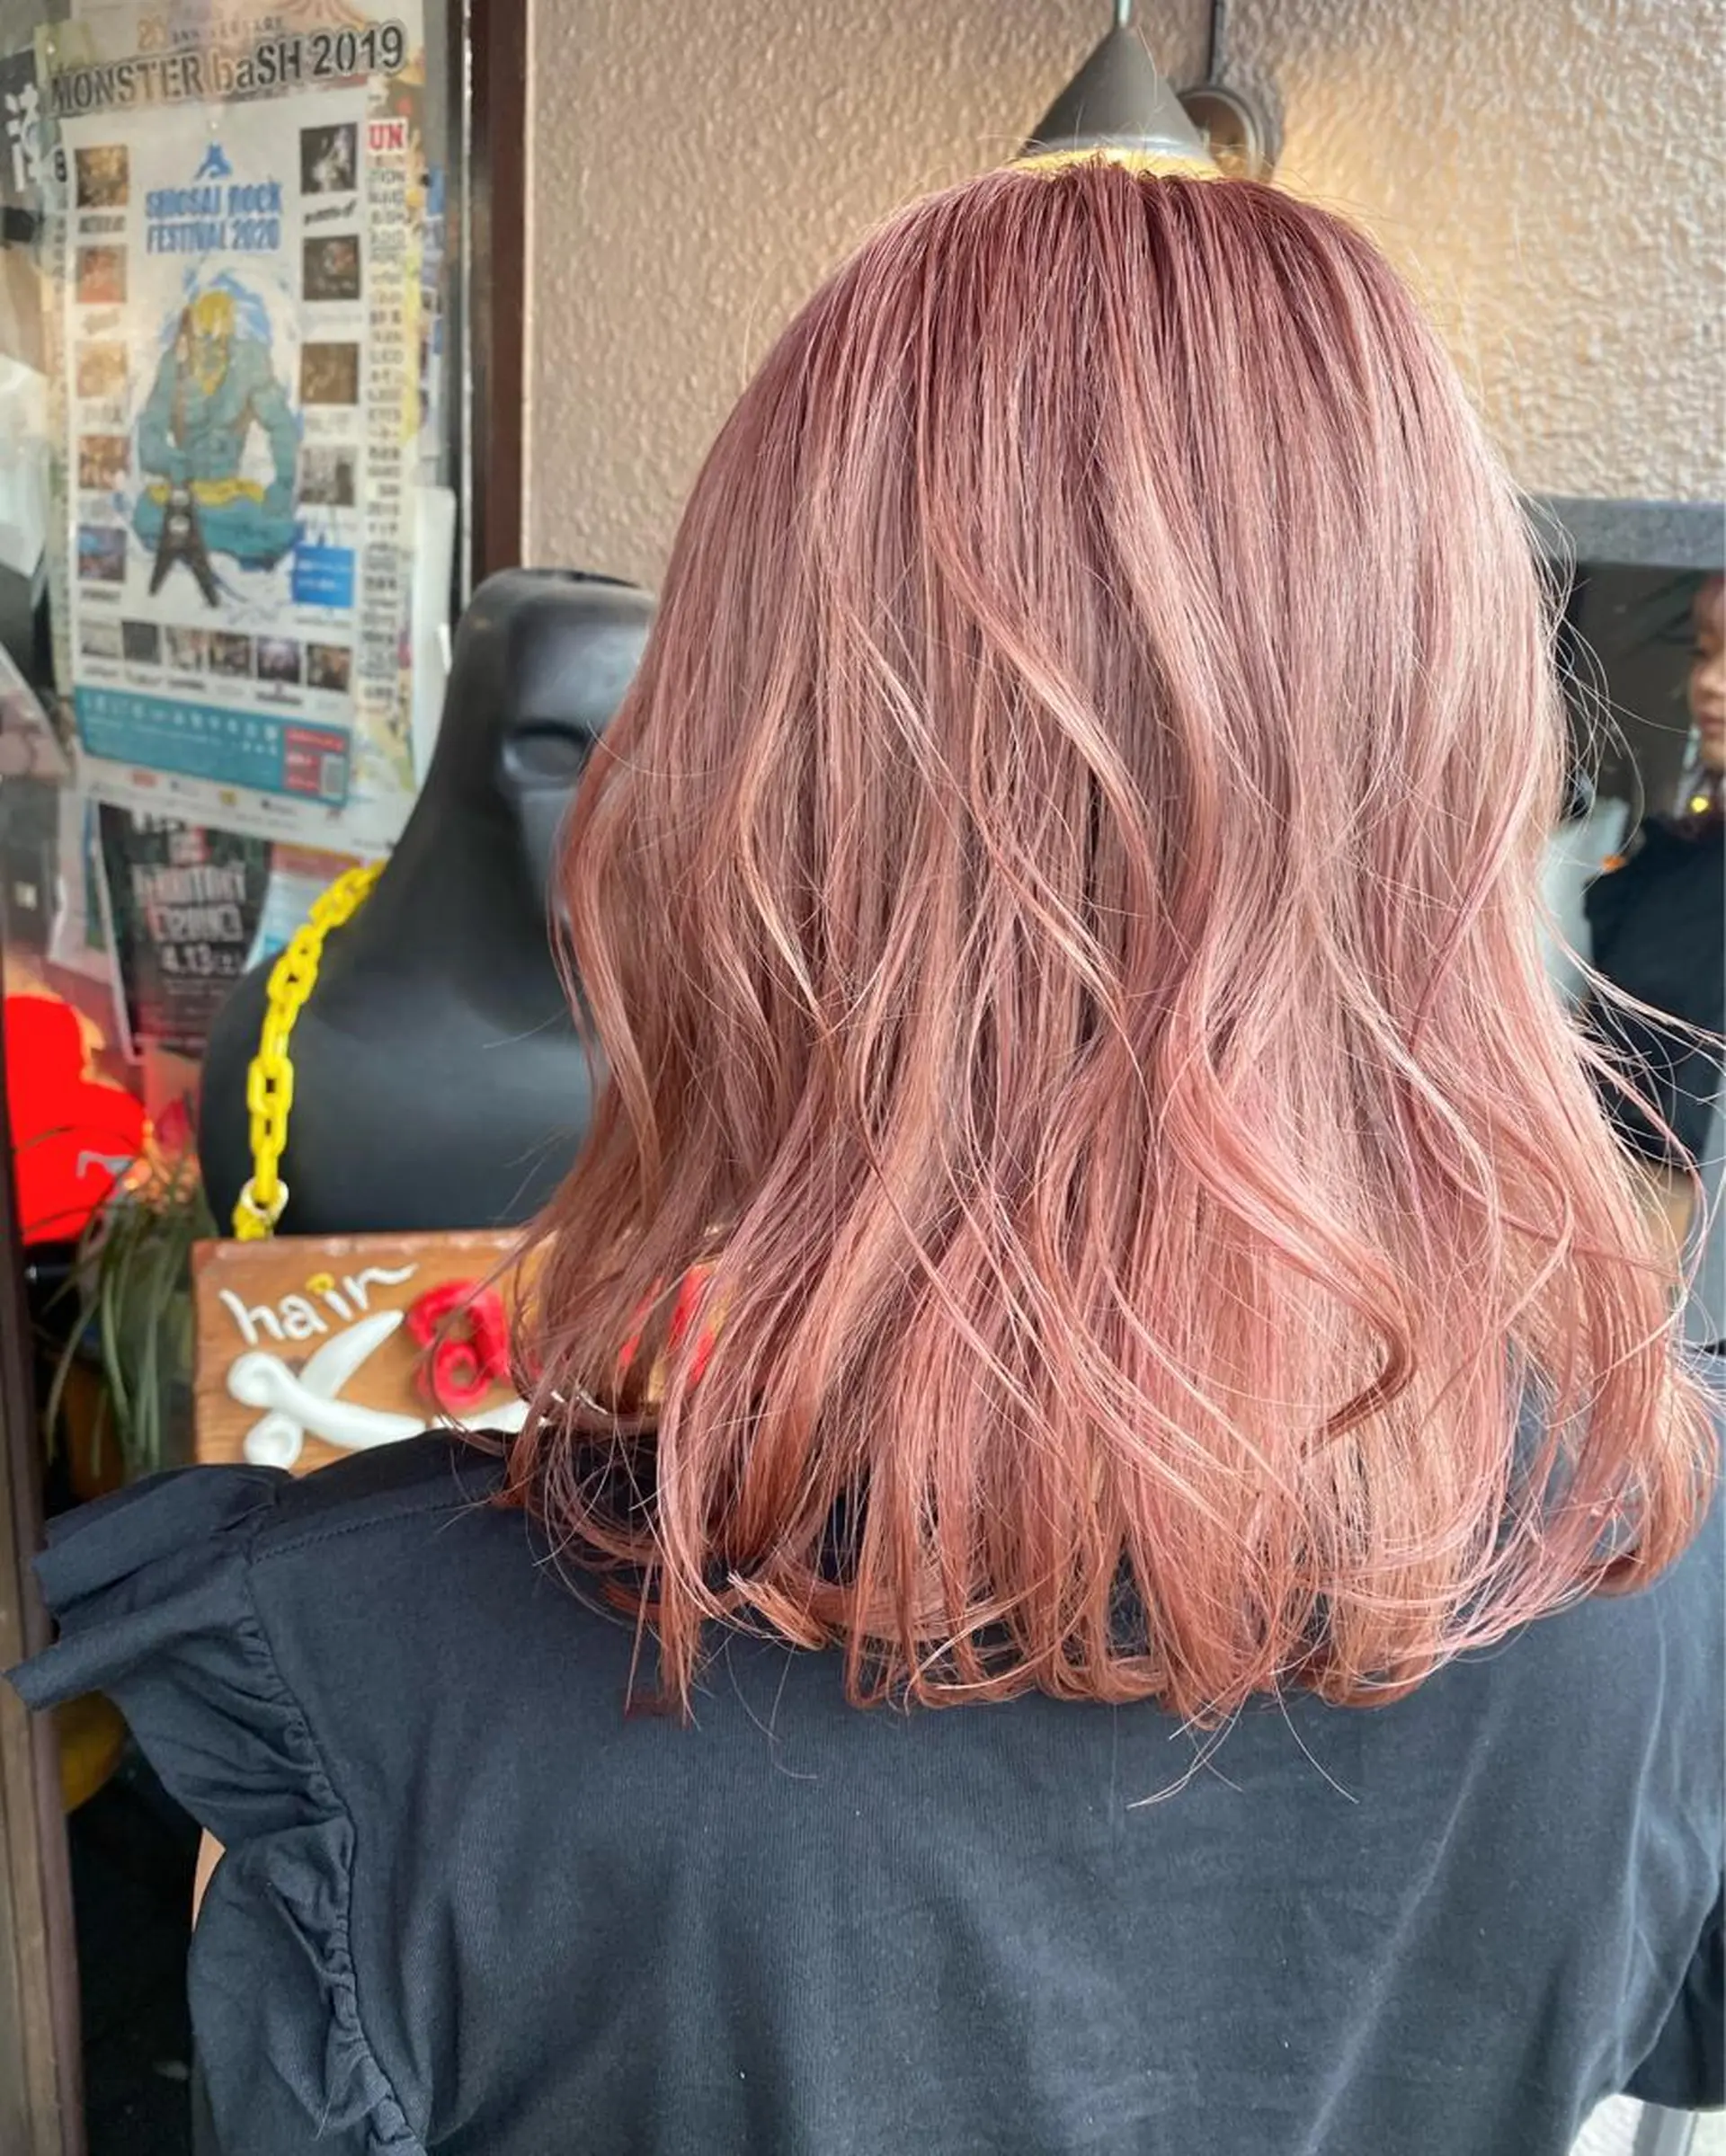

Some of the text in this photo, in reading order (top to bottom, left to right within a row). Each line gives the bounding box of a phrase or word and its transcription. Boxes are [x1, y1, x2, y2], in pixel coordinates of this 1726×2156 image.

[50, 54, 204, 111] MONSTER
[312, 25, 405, 75] 2019
[147, 220, 227, 254] FESTIVAL
[219, 1263, 418, 1345] hair
